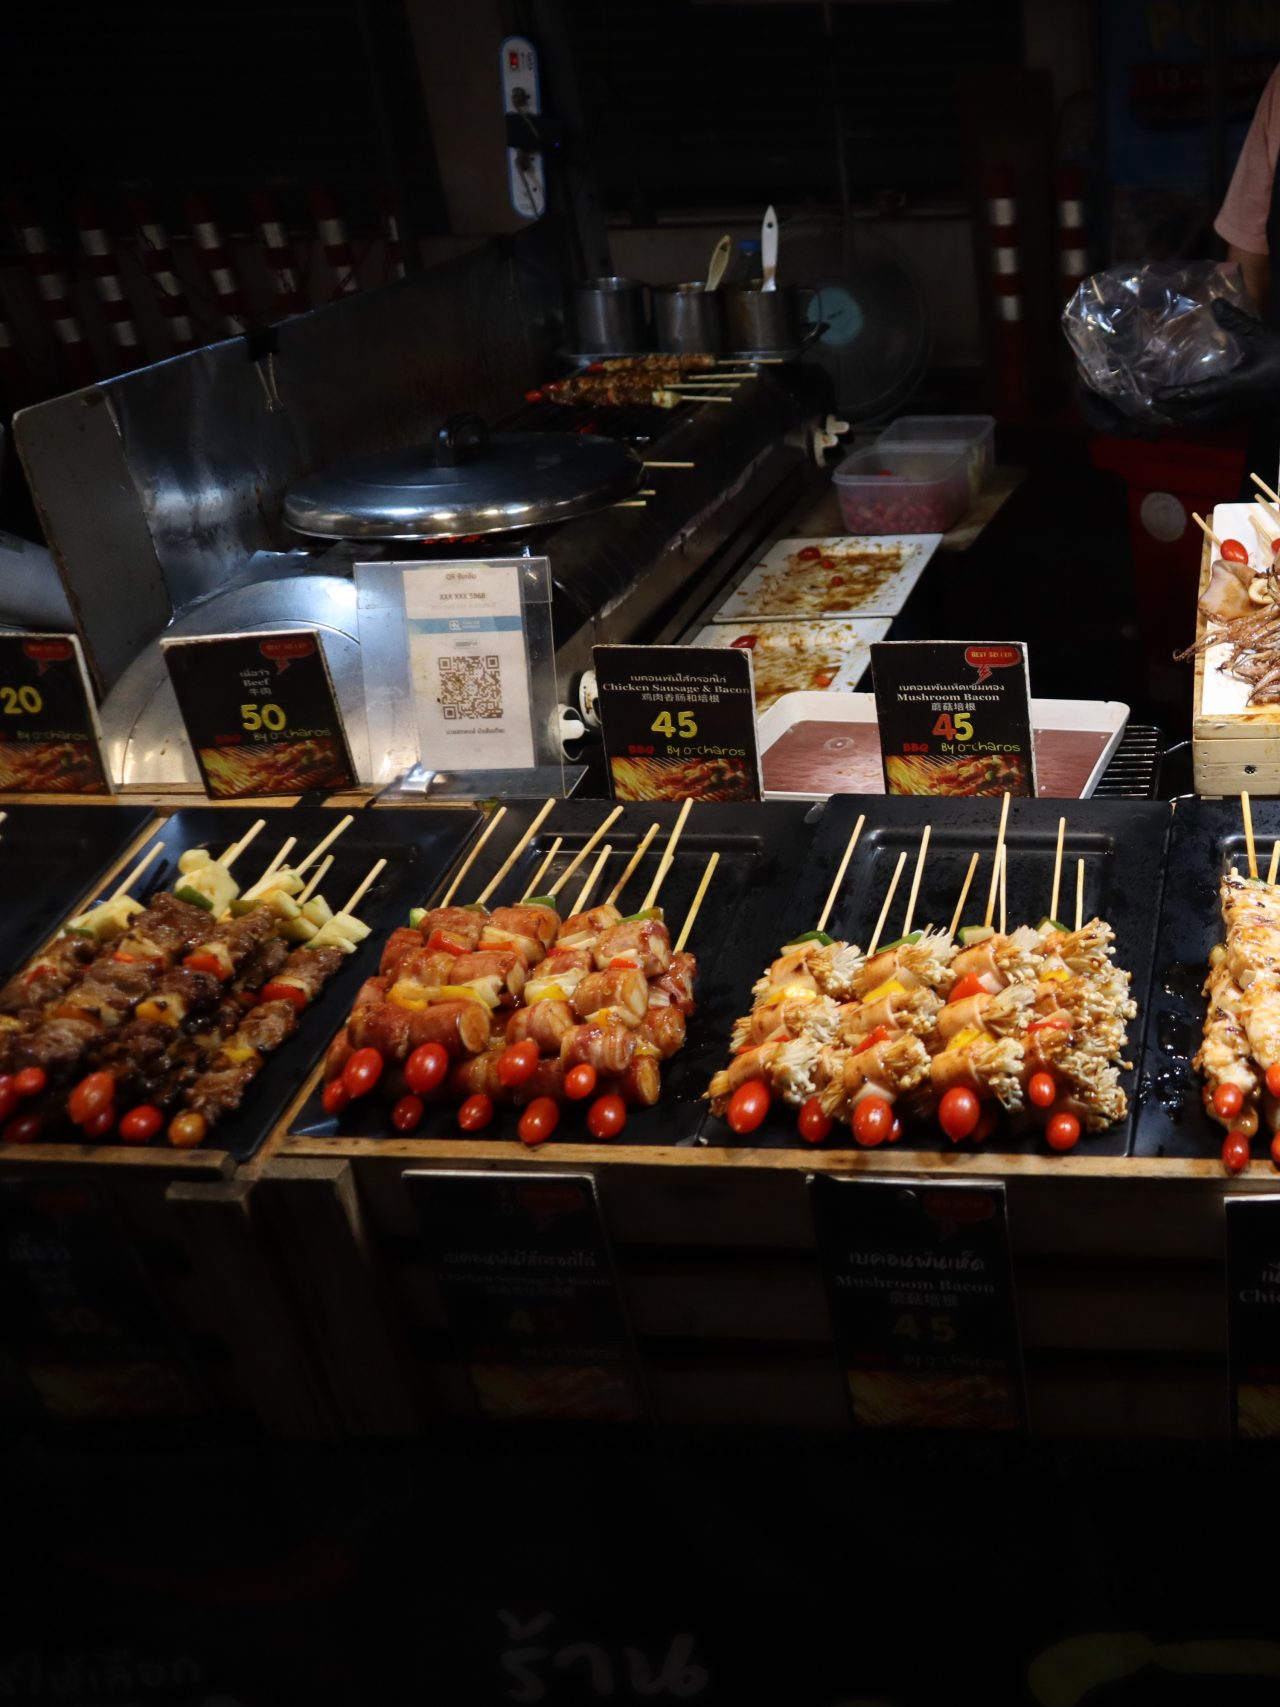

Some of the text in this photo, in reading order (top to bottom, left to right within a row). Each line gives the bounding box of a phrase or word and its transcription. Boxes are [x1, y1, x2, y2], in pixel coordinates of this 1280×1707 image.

[1, 687, 43, 714] 20
[602, 683, 650, 692] Chicken
[652, 684, 700, 694] Sausage
[714, 685, 750, 694] Bacon
[896, 693, 1000, 701] Mushroom Bacon
[241, 704, 287, 732] 50
[651, 711, 698, 738] 45
[932, 712, 975, 742] 45
[666, 745, 680, 756] By
[941, 743, 955, 754] By
[835, 1274, 995, 1293] Mushroom Bacon
[893, 1312, 957, 1343] 45
[496, 1607, 708, 1703] ร้าน
